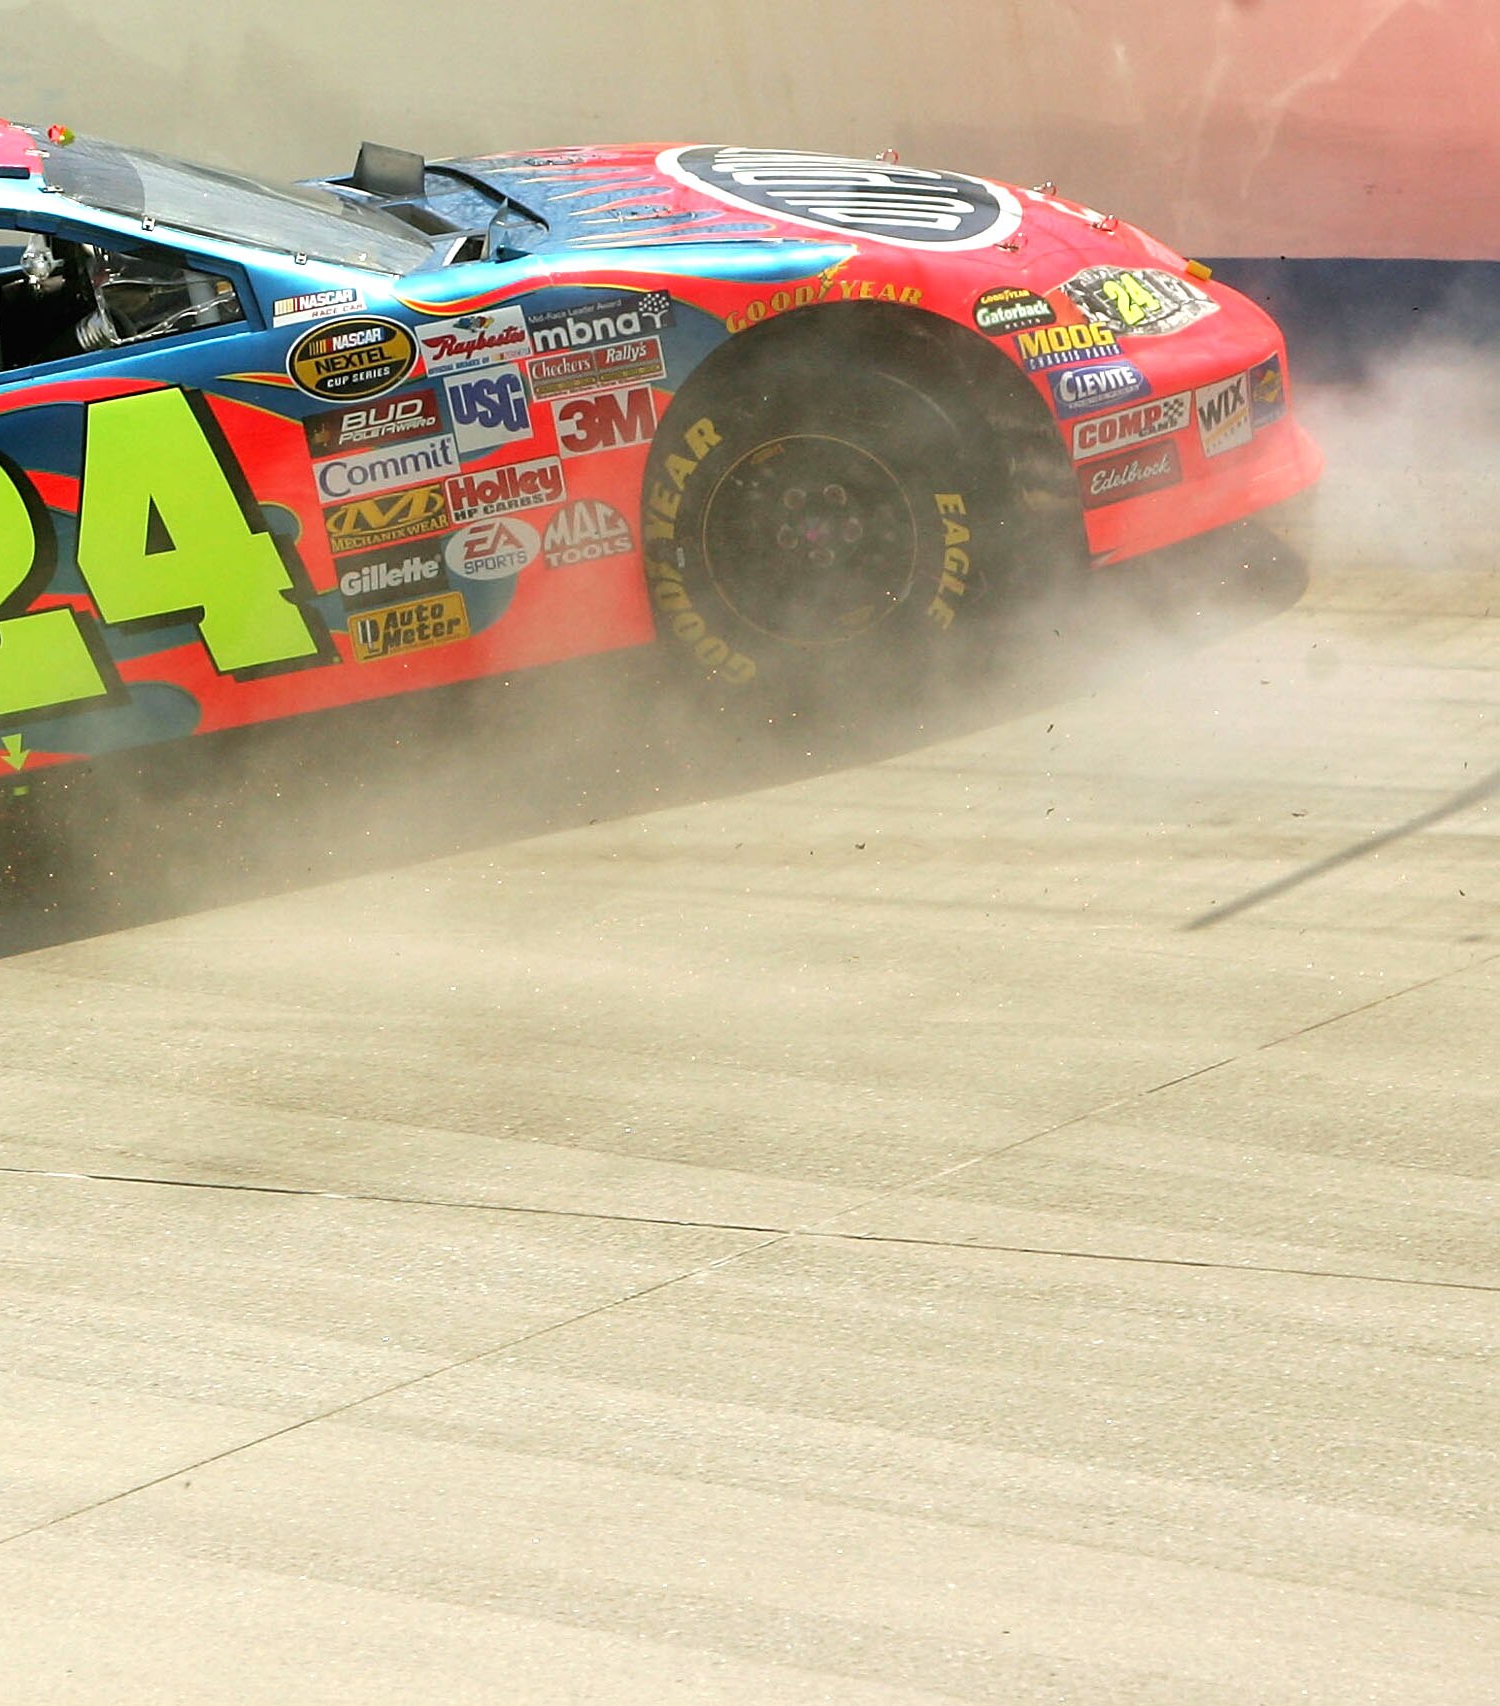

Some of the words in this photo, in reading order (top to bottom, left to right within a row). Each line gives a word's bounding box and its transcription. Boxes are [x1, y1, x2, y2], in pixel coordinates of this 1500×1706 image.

[298, 289, 354, 310] NASCAR
[311, 308, 338, 318] RACE
[343, 303, 363, 313] CAR
[976, 300, 1051, 328] Gatorback
[1103, 272, 1162, 326] 24
[332, 328, 382, 351] NASCAR
[533, 310, 641, 352] mbna
[1018, 322, 1116, 360] MOOG
[314, 347, 393, 375] NEXTEL
[531, 356, 591, 380] Checkers
[605, 341, 647, 364] Rally's
[327, 375, 350, 389] CUP
[352, 366, 391, 384] SERIES
[1059, 366, 1138, 403] CLEVITE
[341, 398, 424, 433] BUD
[449, 373, 529, 432] USG
[558, 387, 658, 453] 3M
[1197, 382, 1247, 433] WIX
[1077, 405, 1164, 450] COMP
[318, 437, 454, 498] Commit
[1090, 452, 1172, 496] Edelbrock
[448, 464, 564, 511] Holley
[453, 508, 479, 523] HP
[483, 493, 546, 517] CARBS
[544, 500, 630, 550] MAC
[463, 521, 524, 560] EA
[545, 535, 634, 568] TOOLS
[339, 556, 440, 597] Gillette
[463, 550, 529, 575] SPORTS
[928, 493, 972, 631] EAGLE
[384, 601, 444, 630] Auto
[381, 616, 461, 654] Meter
